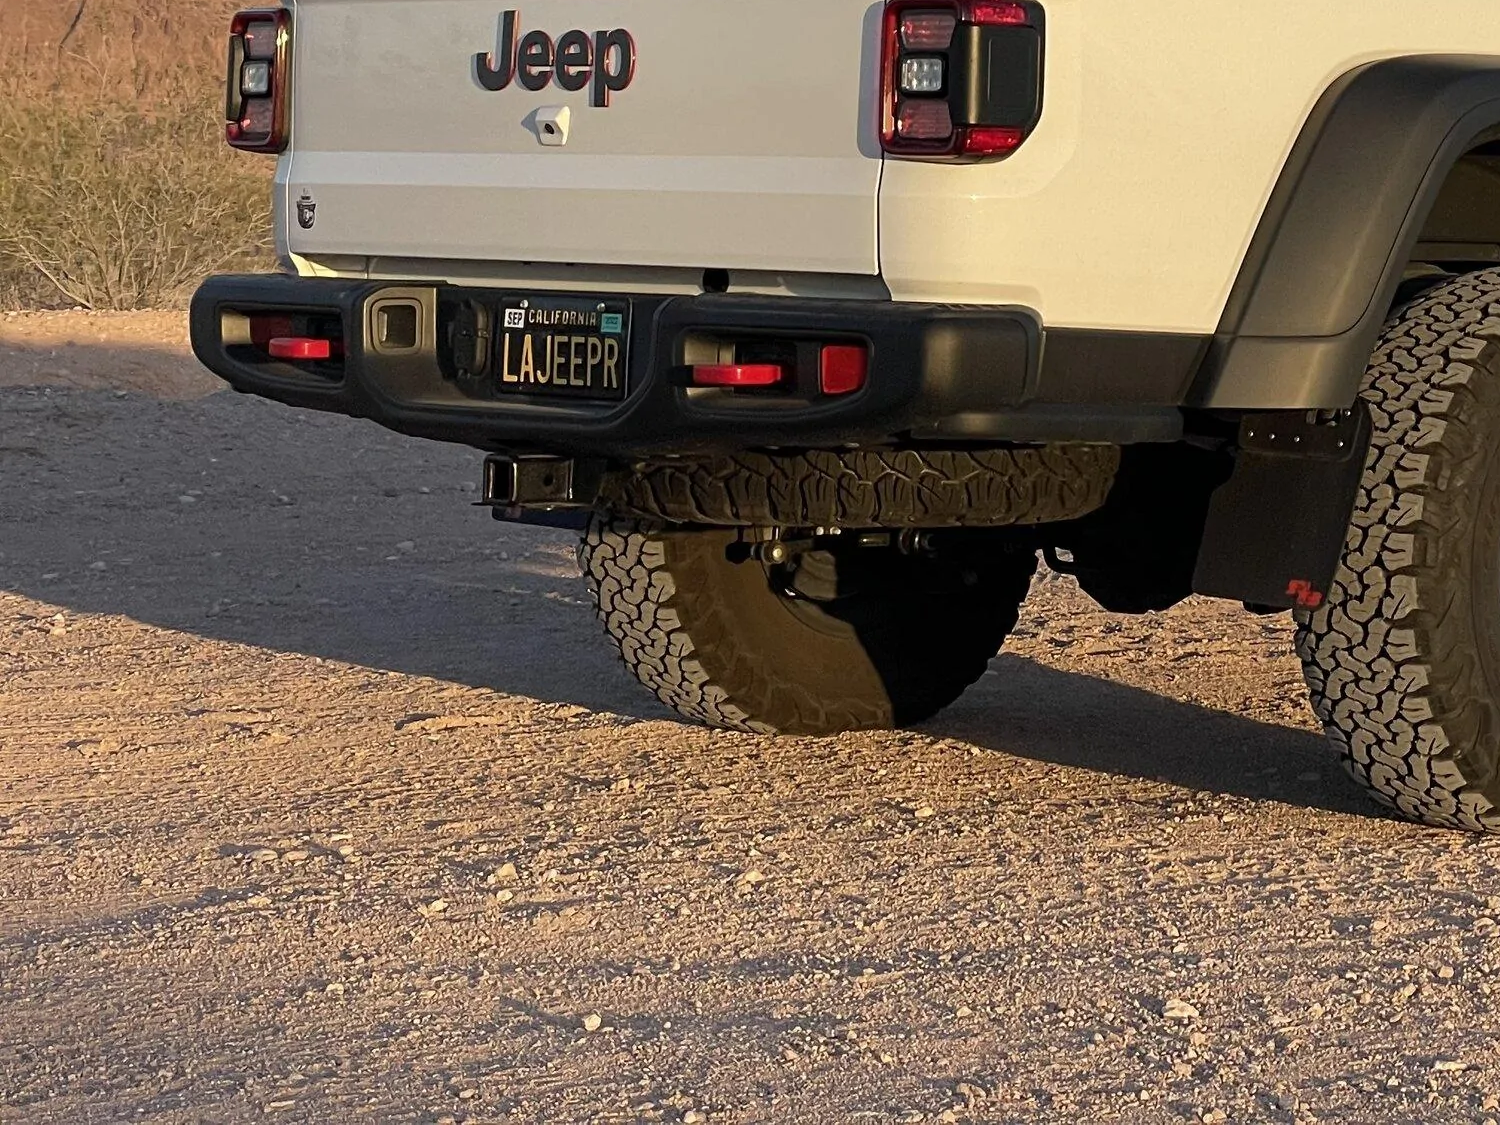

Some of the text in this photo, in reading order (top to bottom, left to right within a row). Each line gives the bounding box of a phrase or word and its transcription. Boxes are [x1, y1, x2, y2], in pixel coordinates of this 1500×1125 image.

[476, 9, 636, 107] Jeep
[507, 311, 523, 325] SEP
[528, 309, 596, 326] CALIFORNIA
[503, 332, 619, 388] LAJEEPR
